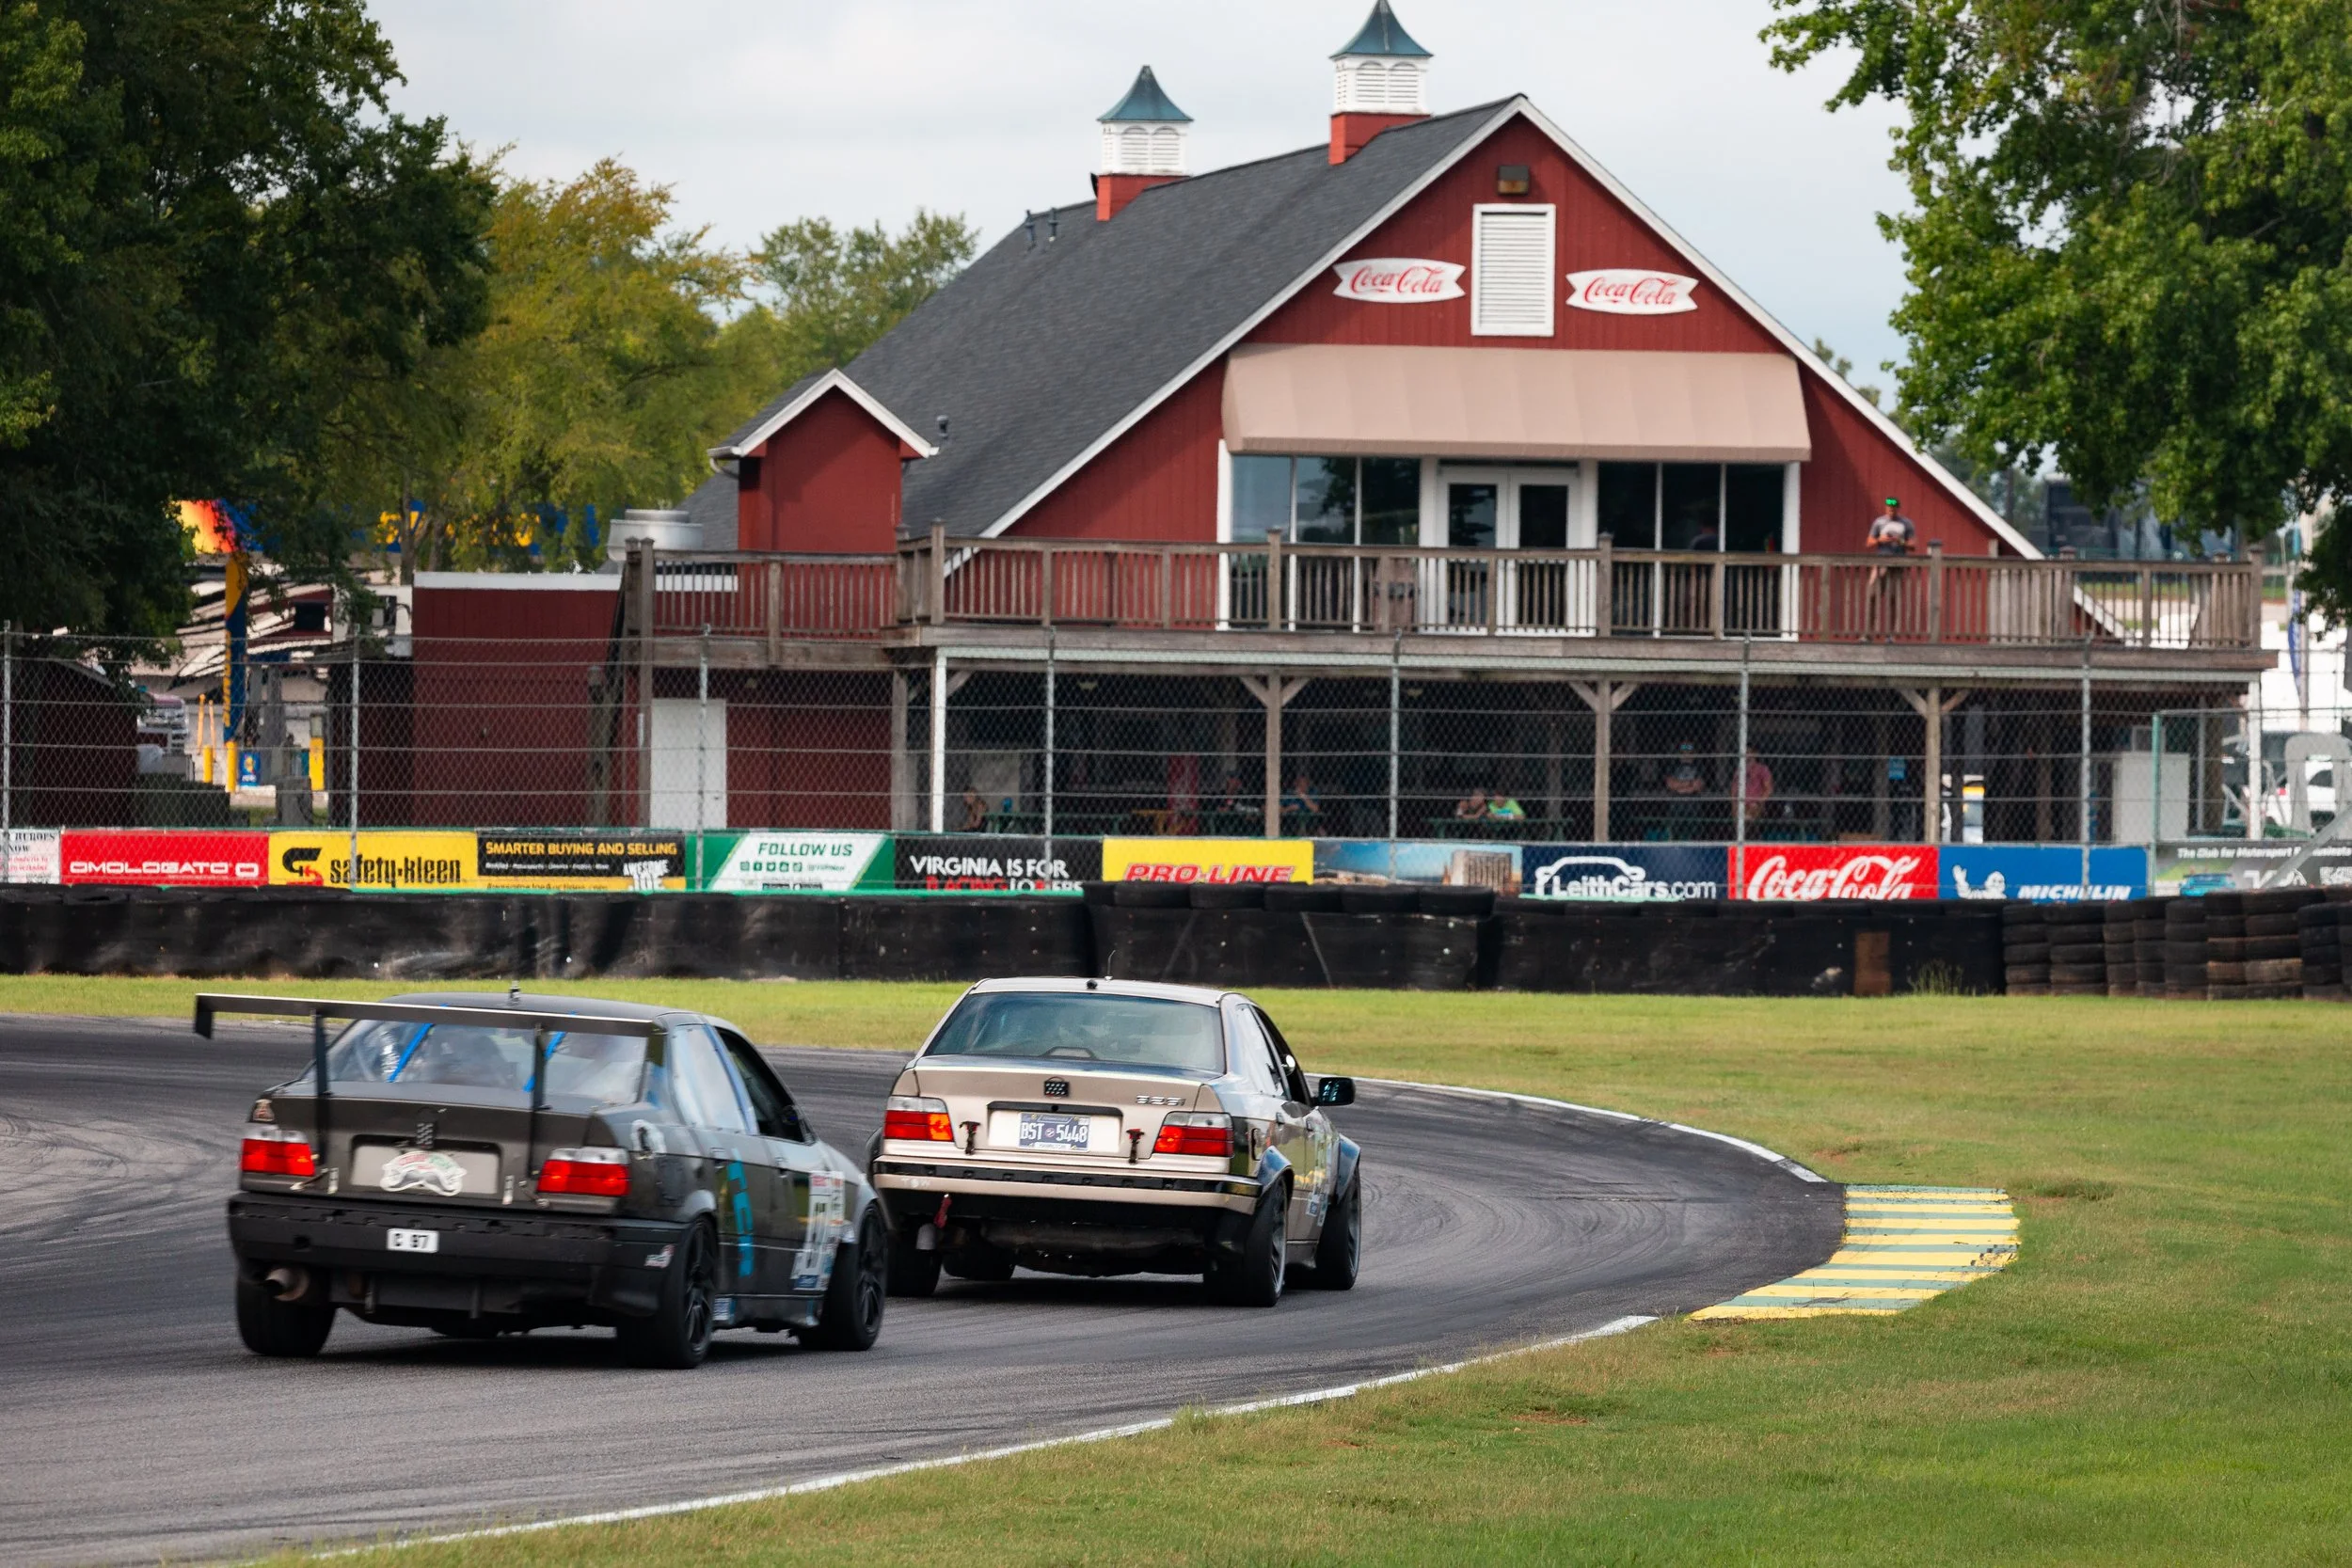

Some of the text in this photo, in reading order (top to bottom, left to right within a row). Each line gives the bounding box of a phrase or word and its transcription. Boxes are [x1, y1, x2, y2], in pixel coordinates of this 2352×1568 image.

[1350, 265, 1444, 293] Coca-Cola
[1584, 277, 1679, 305] Coca-Cola
[485, 842, 678, 856] SMARTER BUYING AND SELLING
[758, 843, 853, 856] FOLLOW US
[70, 861, 230, 875] OMOLOGATO
[910, 855, 1070, 879] VIRGINIA IS FOR
[1124, 863, 1295, 884] PRO-LINE
[1747, 855, 1922, 901] Coca-Cola
[1552, 875, 1717, 899] LeithCars.com
[1021, 1122, 1089, 1143] BST 5448
